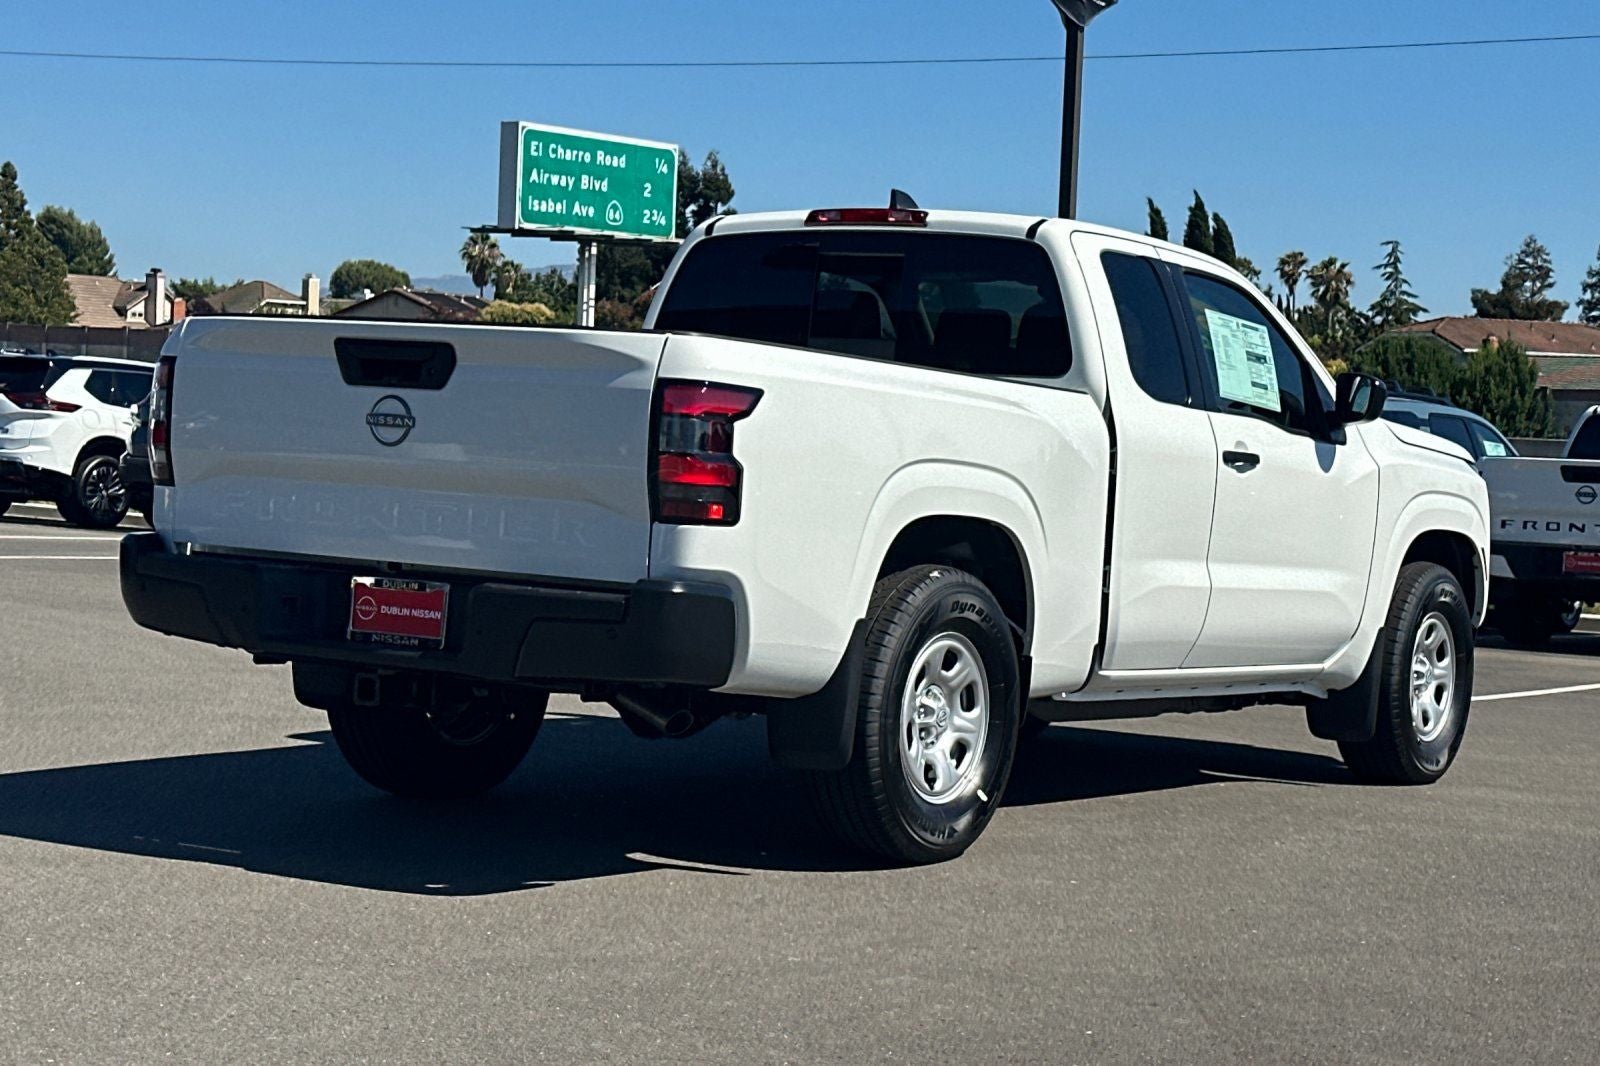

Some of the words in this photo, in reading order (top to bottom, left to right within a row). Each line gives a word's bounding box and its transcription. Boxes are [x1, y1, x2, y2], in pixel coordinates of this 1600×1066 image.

[530, 141, 543, 157] El
[549, 143, 591, 163] Charro
[596, 151, 626, 168] Road
[529, 168, 575, 191] Airway
[581, 174, 608, 192] Blvd
[643, 182, 651, 198] 2
[528, 195, 567, 215] Isabel
[572, 201, 595, 218] Ave
[367, 414, 413, 427] NISSAN
[380, 605, 410, 616] DUBLIN
[411, 608, 441, 620] NISSAN
[371, 633, 419, 646] NISSAN
